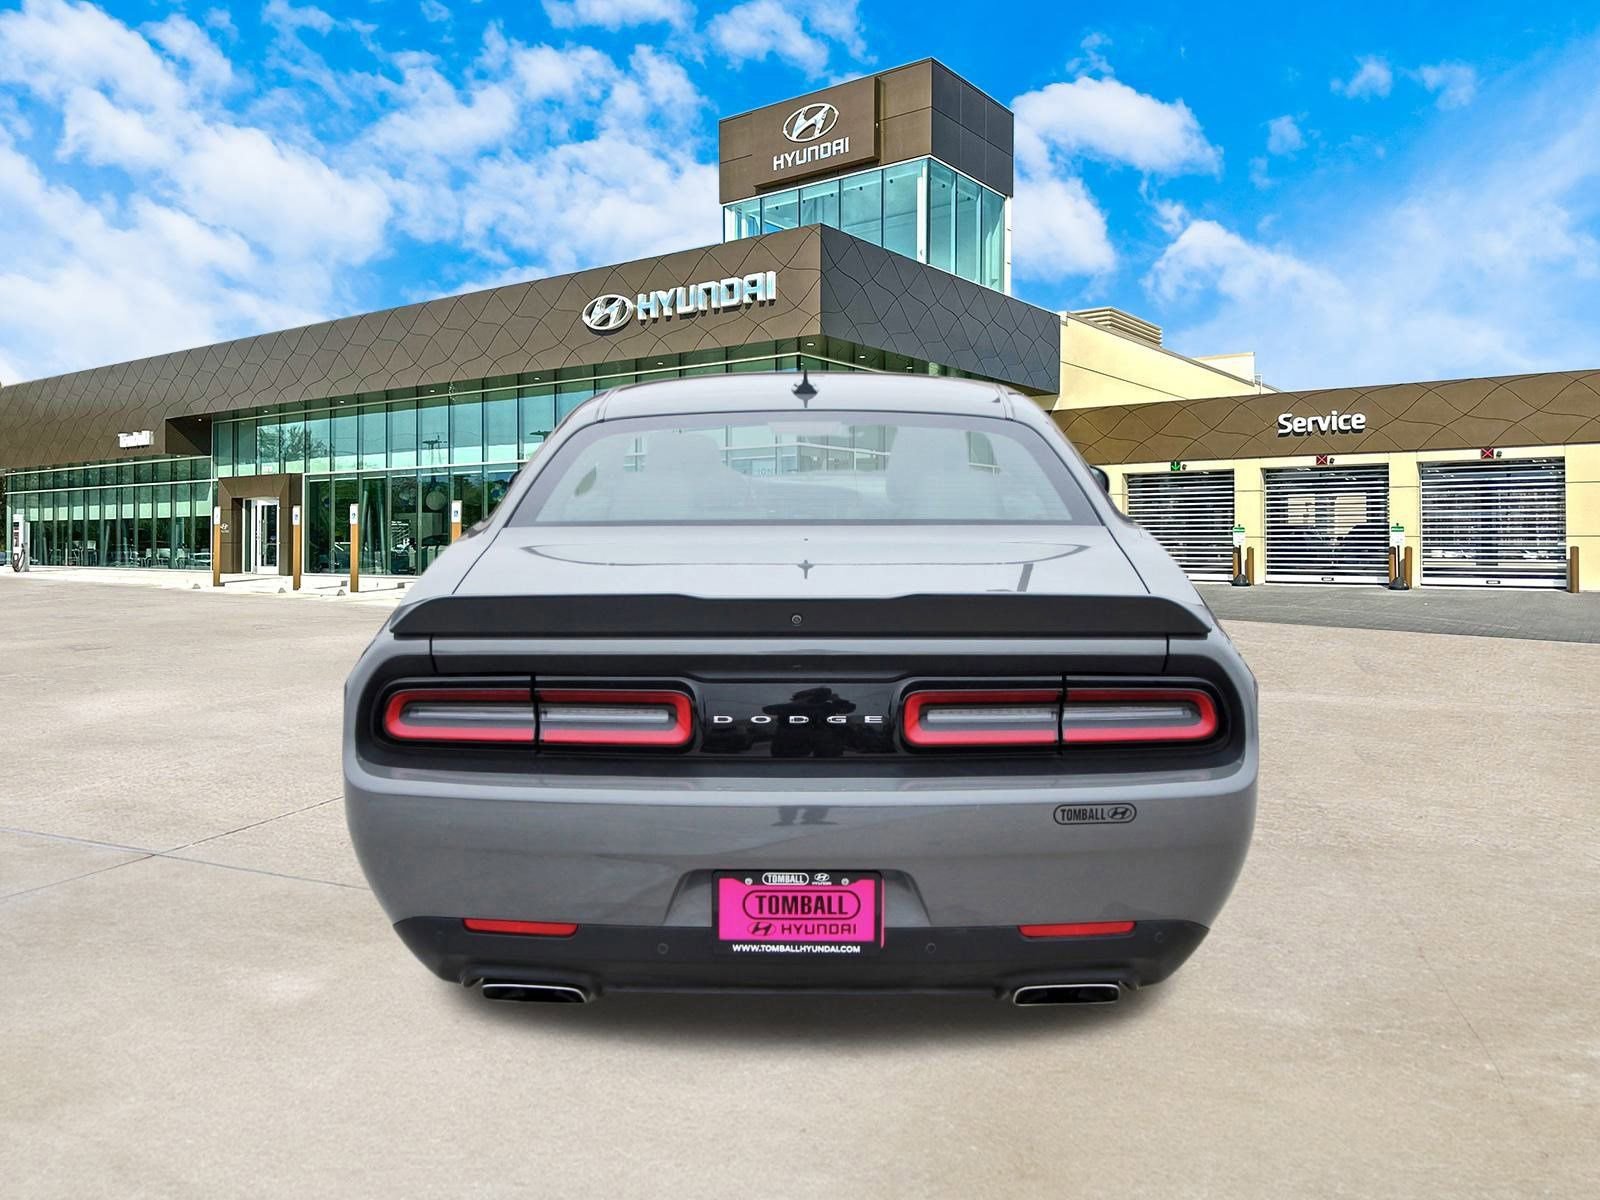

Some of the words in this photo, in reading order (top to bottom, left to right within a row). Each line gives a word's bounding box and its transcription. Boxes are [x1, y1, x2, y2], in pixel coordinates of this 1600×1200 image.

[772, 136, 850, 171] HYUNDAI
[636, 270, 778, 322] HYUNDAI
[1277, 410, 1367, 436] Service
[713, 715, 883, 724] DODGE
[1060, 807, 1106, 821] TOMBALL
[767, 874, 805, 884] TOMBALL
[755, 895, 849, 915] TOMBALL
[781, 923, 857, 935] HYUNDAI
[732, 943, 861, 954] WWW.TOMBALLHYUNDAI.COM
